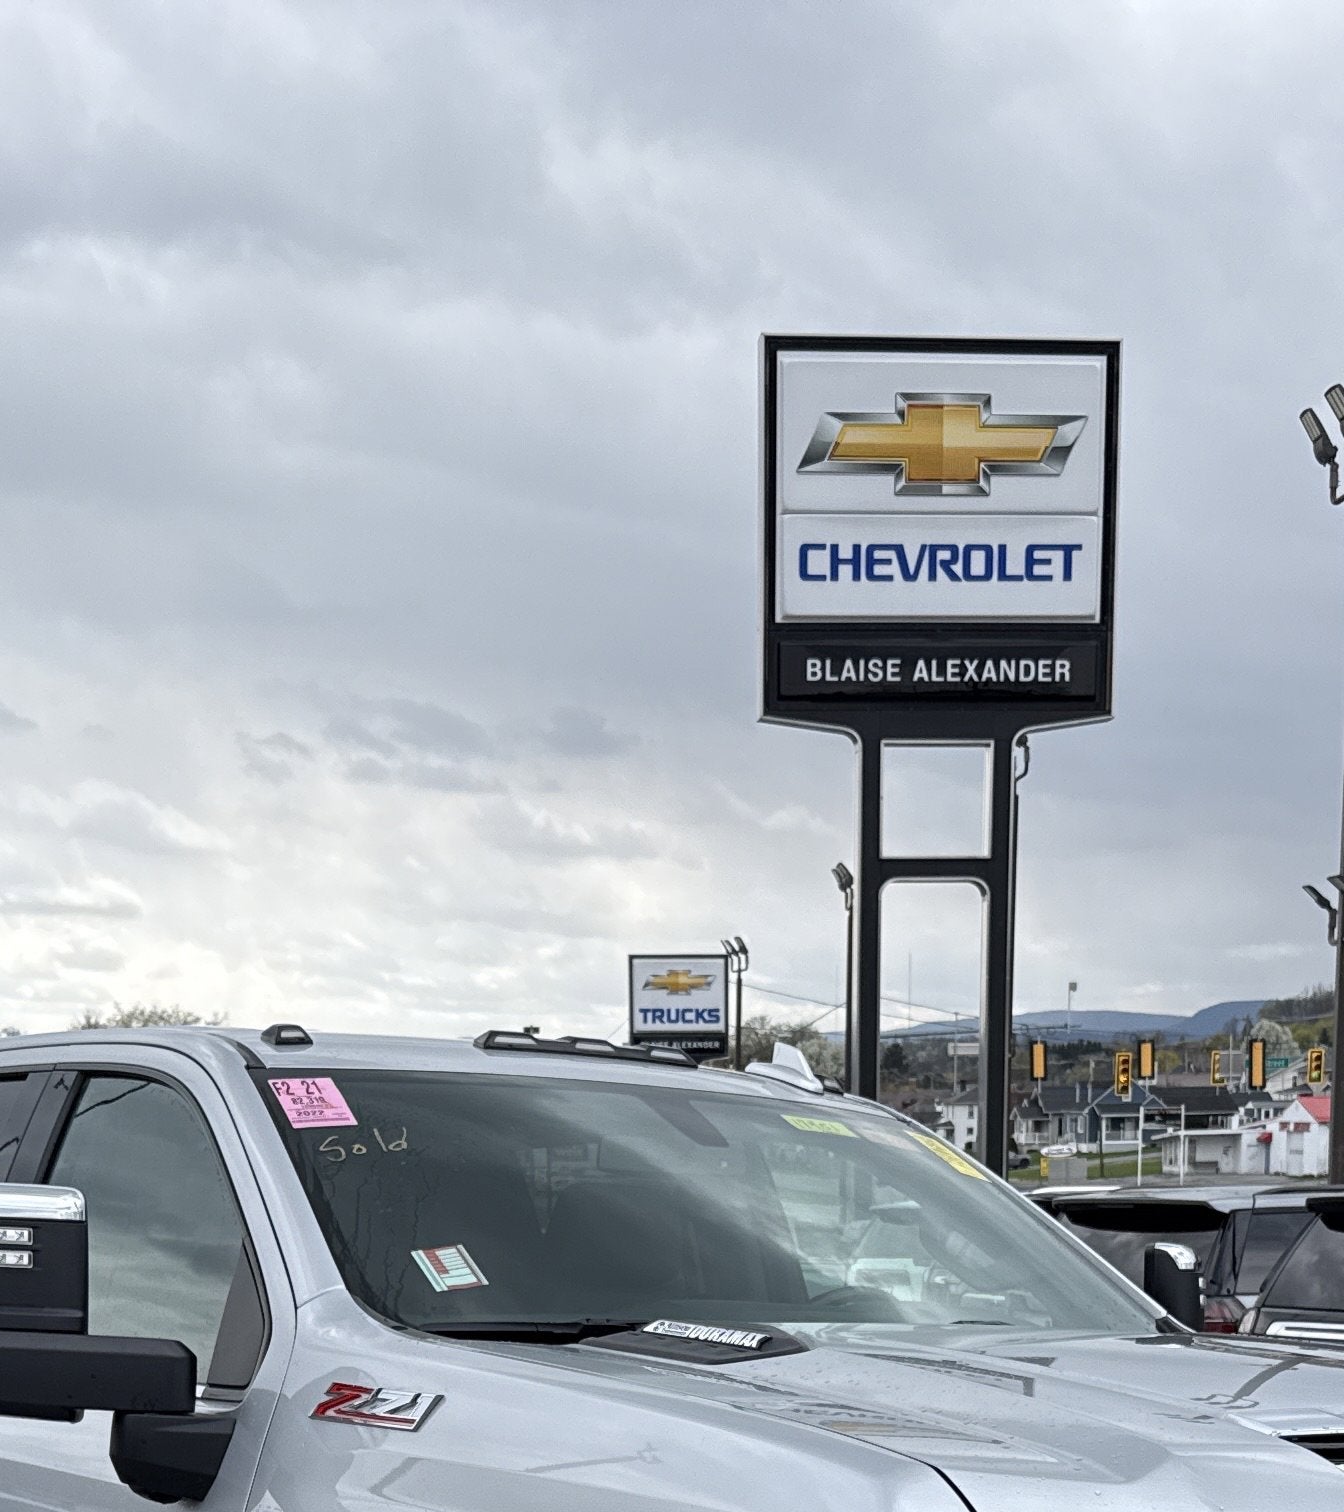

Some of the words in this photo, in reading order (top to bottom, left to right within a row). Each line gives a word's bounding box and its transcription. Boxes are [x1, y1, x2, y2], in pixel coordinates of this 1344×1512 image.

[798, 544, 1083, 582] CHEVROLET
[806, 658, 901, 683] BLAISE
[912, 658, 1071, 683] ALEXANDER
[639, 1008, 721, 1024] TRUCKS
[272, 1081, 295, 1096] F2
[301, 1080, 322, 1096] 21
[295, 1109, 325, 1117] 2022
[319, 1126, 408, 1162] Sold
[687, 1325, 772, 1348] DURAMAX
[308, 1382, 445, 1432] Z71
